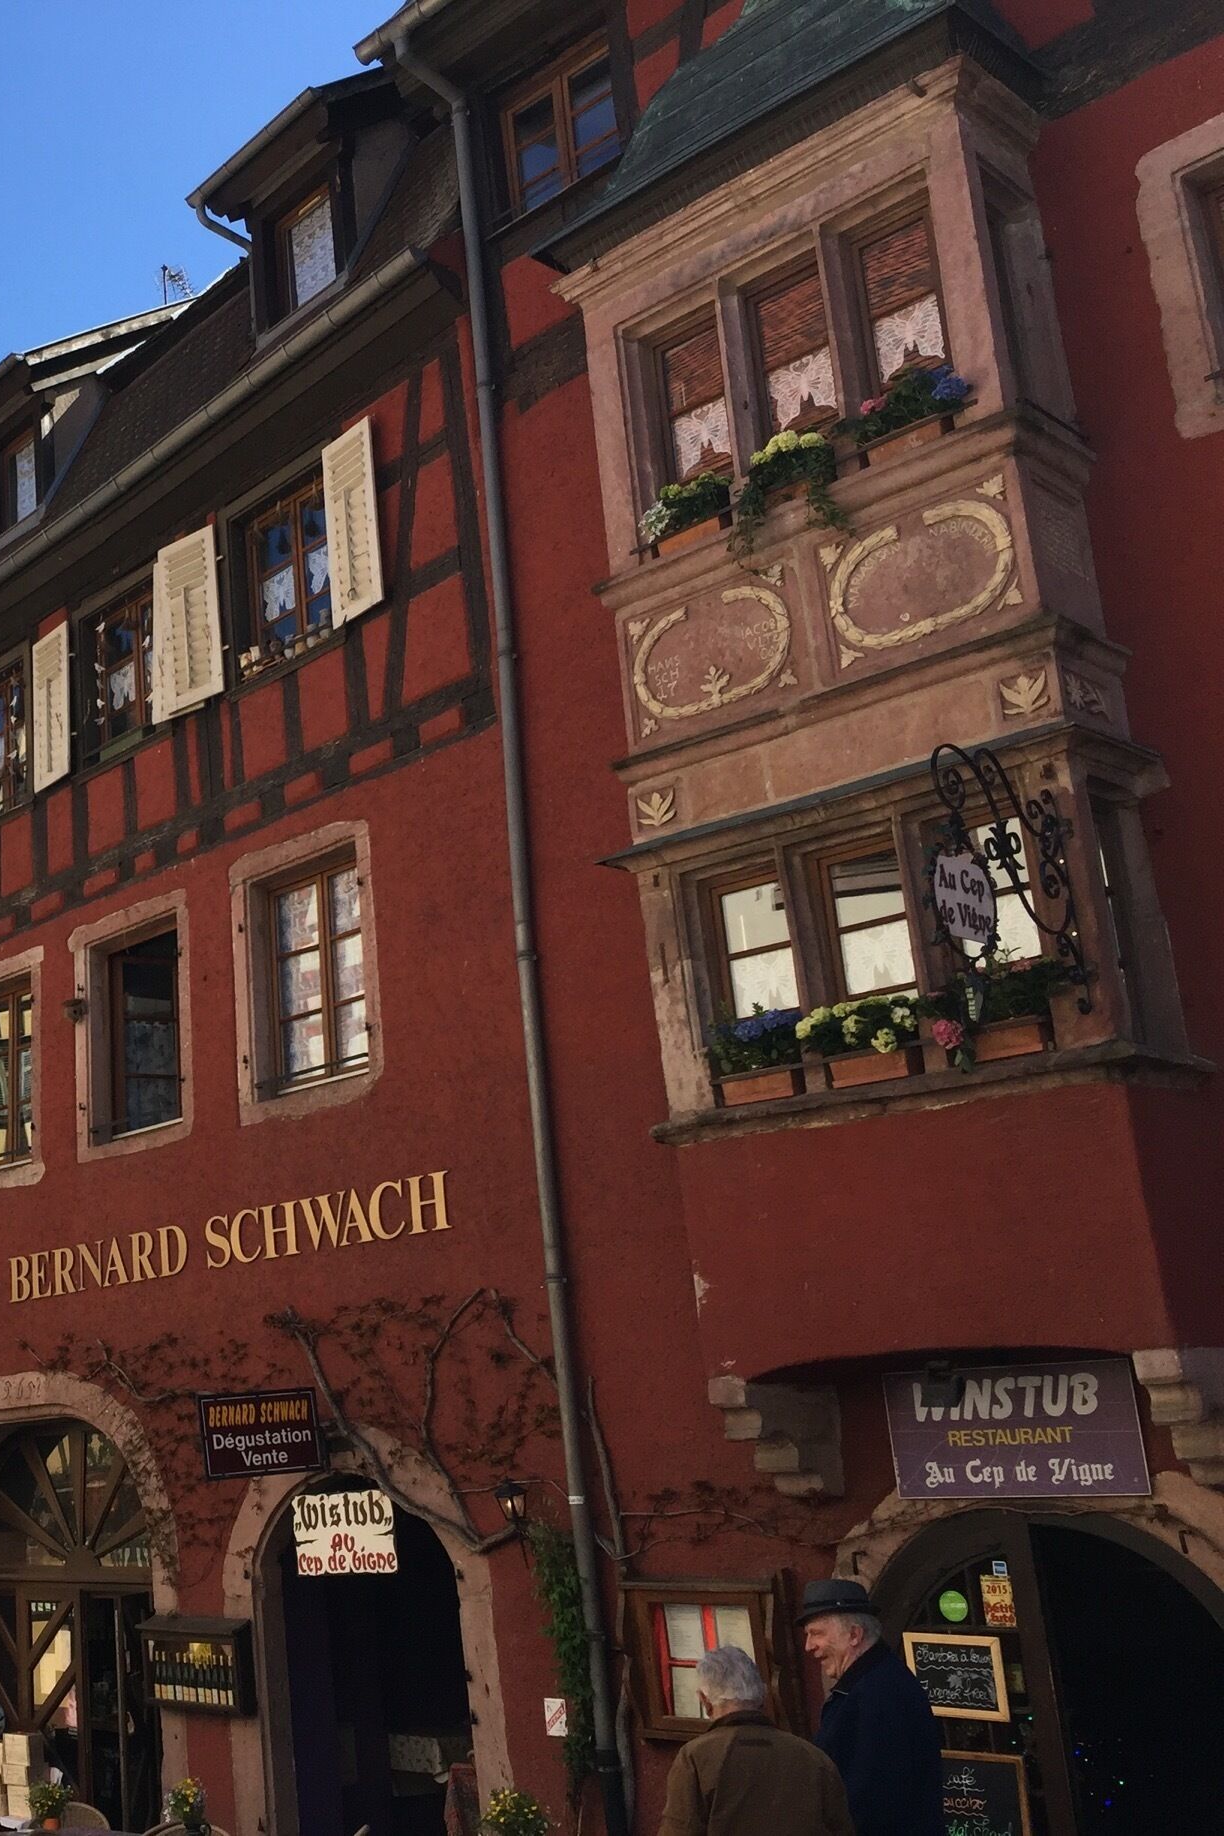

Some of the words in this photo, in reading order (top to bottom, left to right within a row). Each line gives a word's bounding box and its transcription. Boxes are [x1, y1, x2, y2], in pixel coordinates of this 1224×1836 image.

[938, 863, 956, 891] Au
[960, 869, 985, 903] Cep
[939, 899, 956, 925] de
[957, 902, 993, 936] Vigne
[8, 1224, 189, 1304] BERNARD
[204, 1169, 454, 1270] SCHWACH
[208, 1403, 256, 1428] BERNARD
[260, 1399, 309, 1424] SCHWACH
[212, 1427, 313, 1451] Dégustation
[947, 1425, 1074, 1447] RESTAURANT
[241, 1449, 289, 1467] Vente
[925, 1460, 956, 1488] Au
[965, 1458, 1005, 1489] Cep
[1015, 1460, 1038, 1483] de
[1048, 1457, 1115, 1486] Vigne
[327, 1550, 347, 1571] de
[985, 1584, 1008, 1595] 2015
